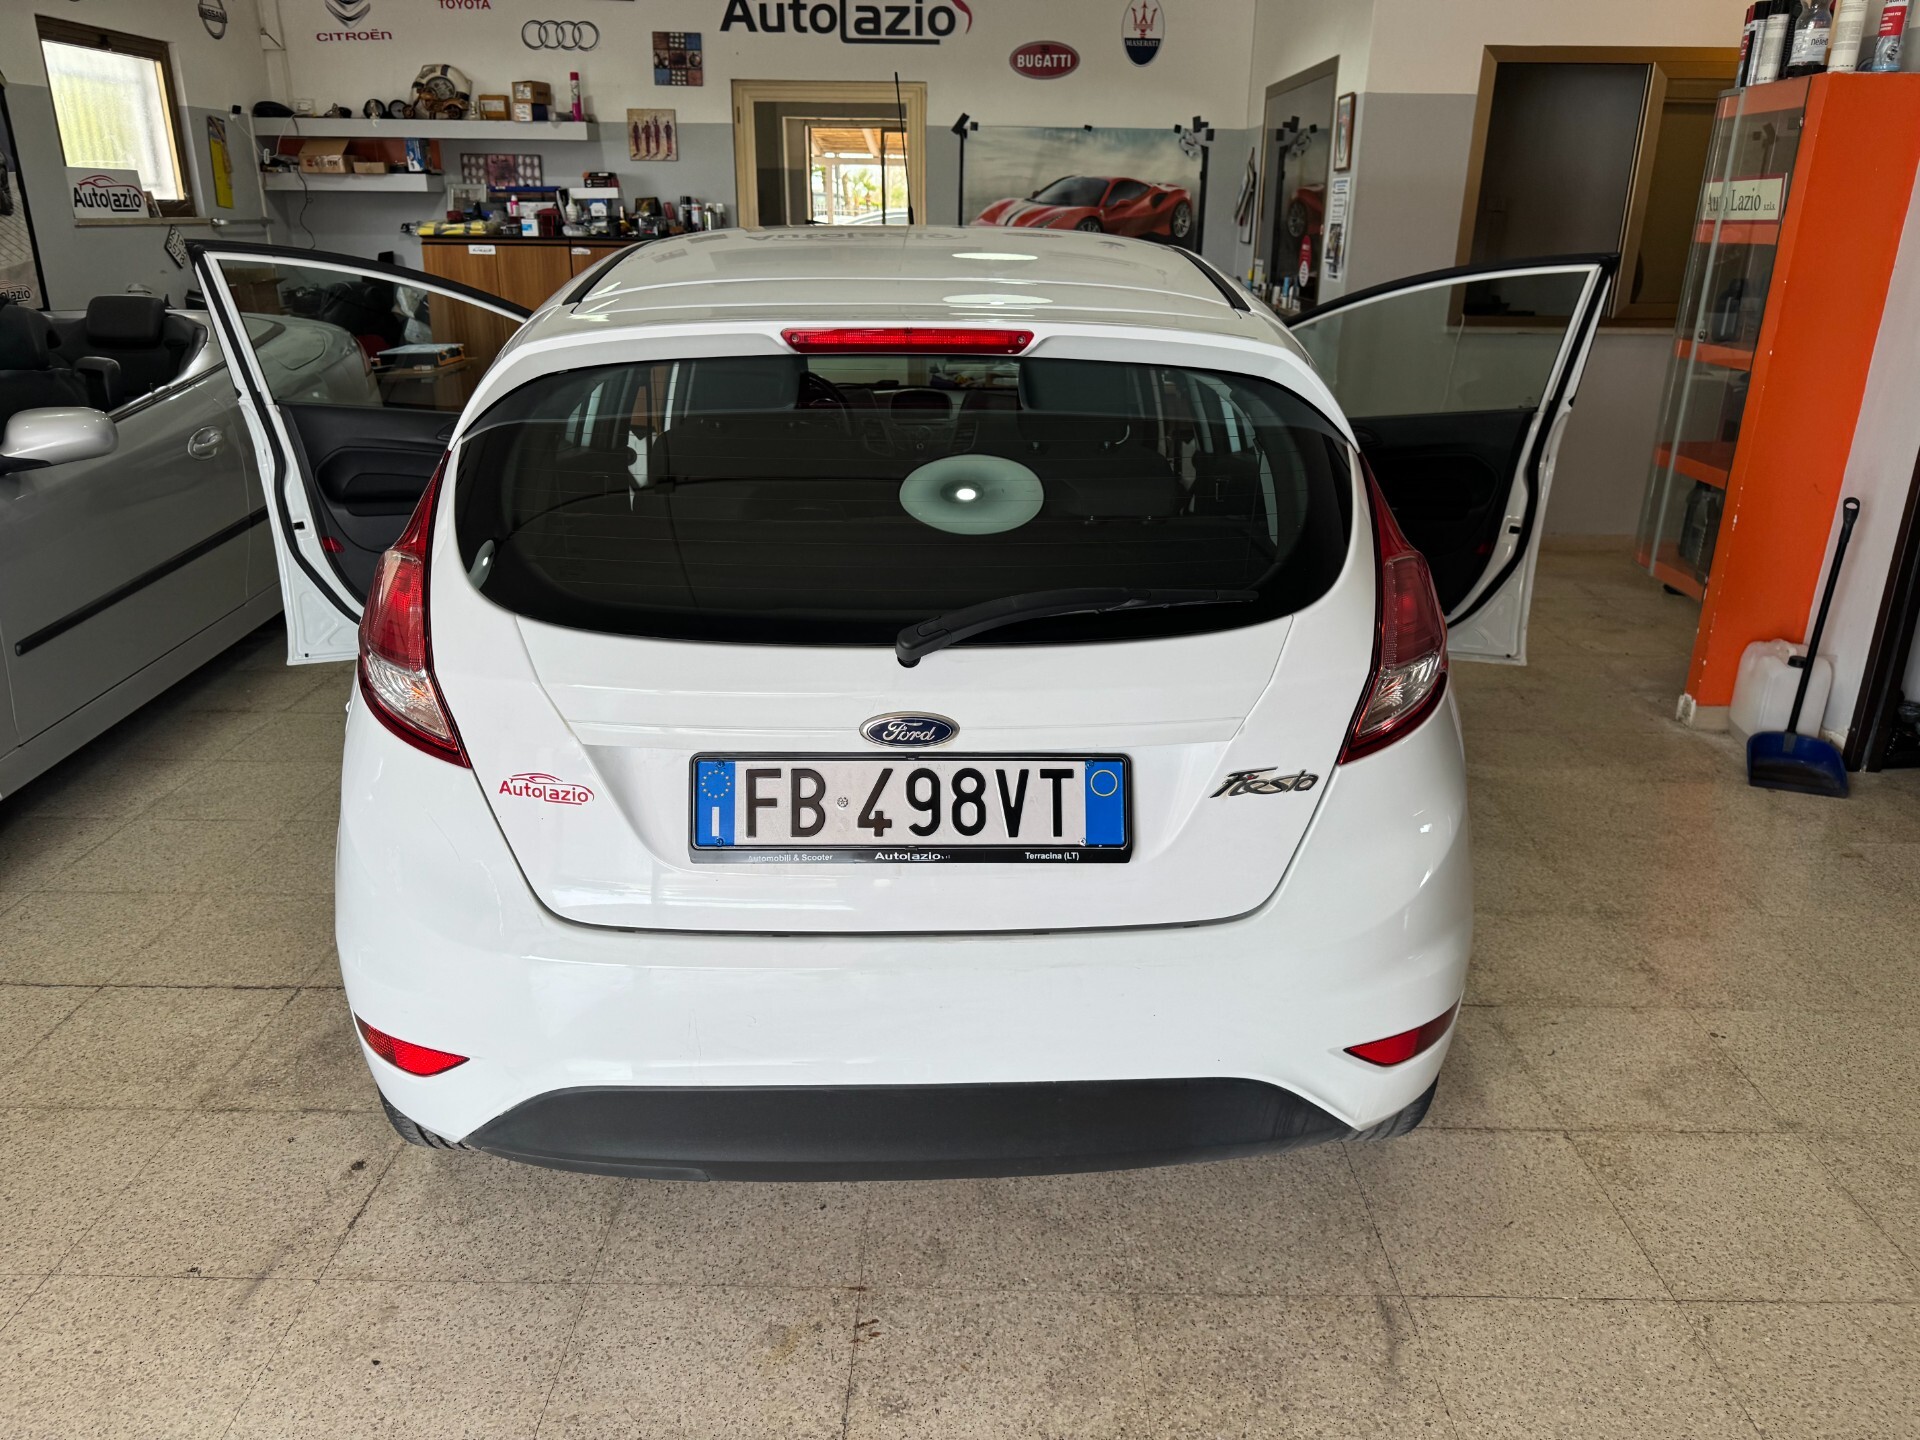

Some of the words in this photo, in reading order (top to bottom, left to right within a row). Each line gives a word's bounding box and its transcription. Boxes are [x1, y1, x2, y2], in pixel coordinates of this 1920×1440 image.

[439, 0, 491, 10] TOYOTA
[1125, 39, 1159, 48] MASERATI
[1017, 54, 1071, 68] BUGATTI
[1730, 187, 1762, 212] Lazio
[882, 721, 937, 741] Ford
[1208, 766, 1319, 798] Fiesta
[745, 768, 826, 838] FB
[857, 767, 1075, 838] 498VT
[748, 854, 791, 863] Automobili
[793, 854, 800, 862] &
[802, 854, 833, 862] Scooter
[1025, 851, 1062, 861] Terracina
[1063, 851, 1080, 861] (LT)
